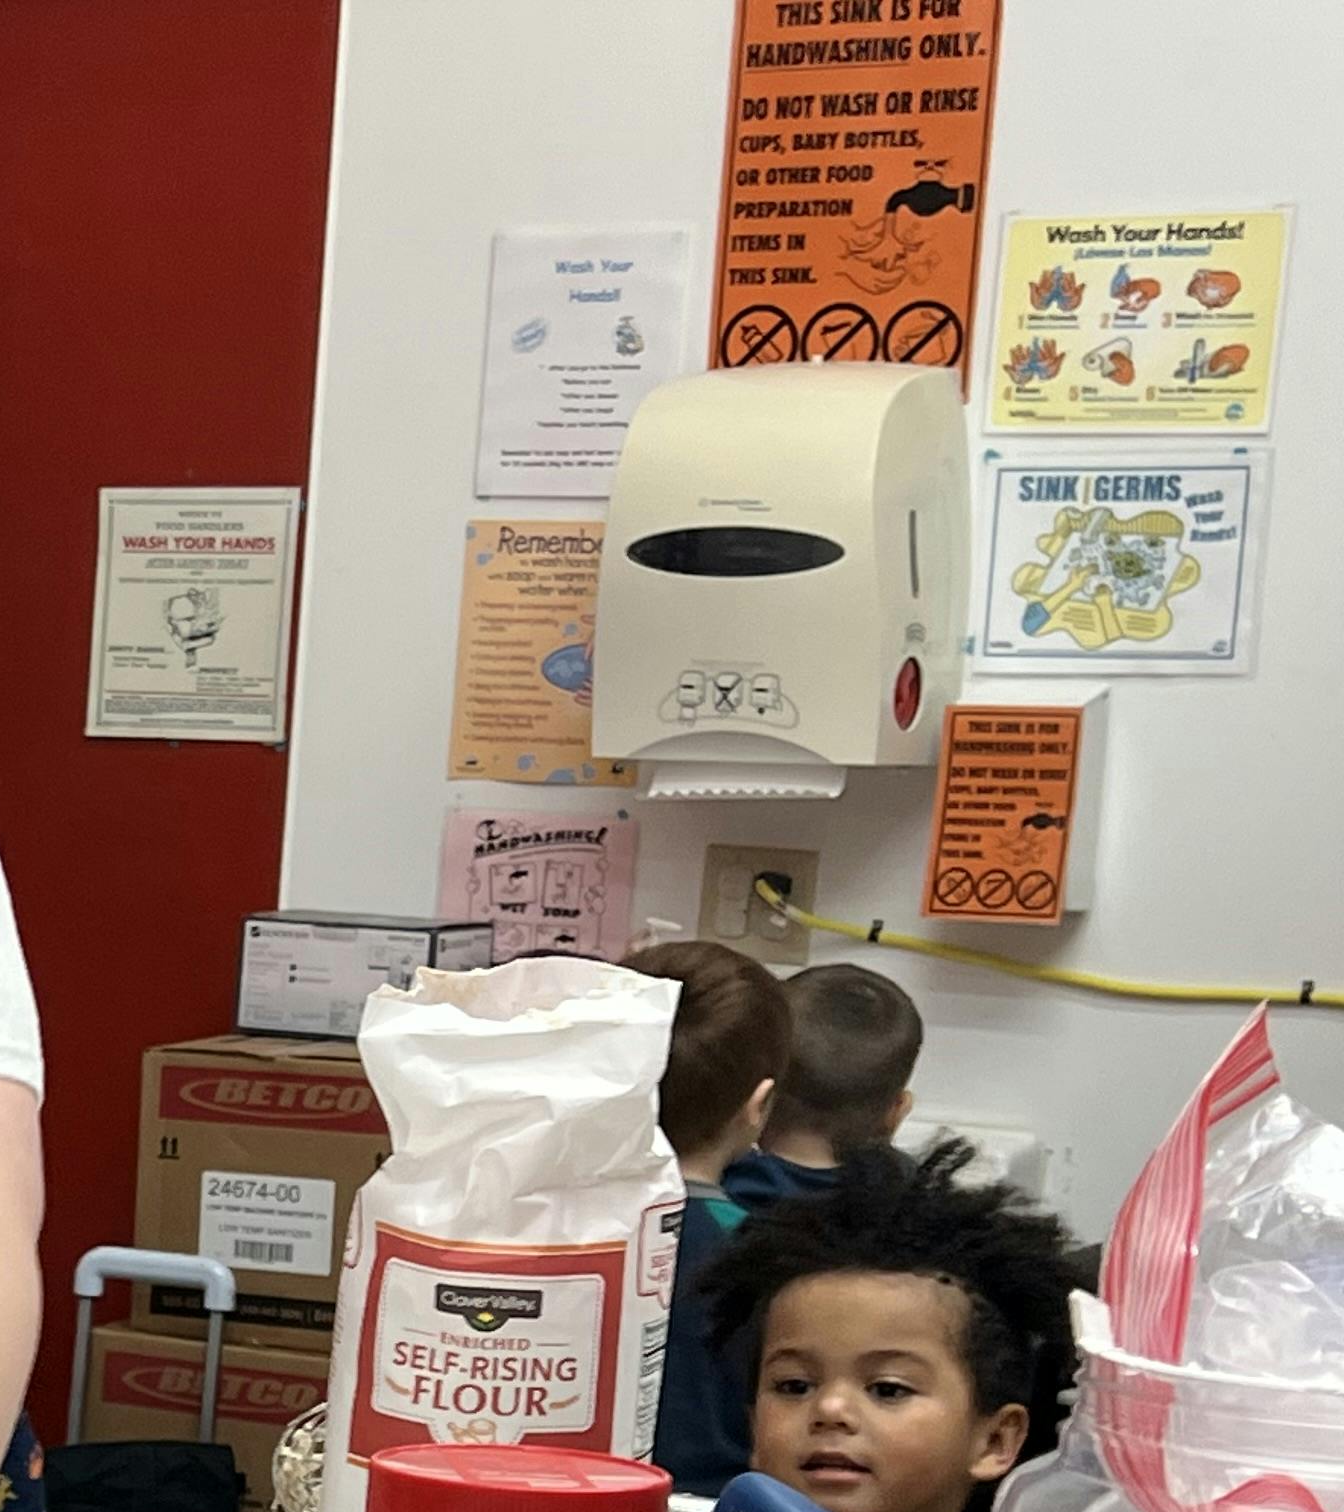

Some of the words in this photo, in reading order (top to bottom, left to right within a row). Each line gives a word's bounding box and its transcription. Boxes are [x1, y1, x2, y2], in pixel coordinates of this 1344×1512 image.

[776, 2, 822, 28] THIS
[830, 0, 881, 25] SINK
[891, 0, 911, 21] IS
[746, 35, 912, 68] HANDWASHING
[919, 31, 987, 59] ONLY.
[742, 97, 768, 121] DO
[775, 95, 814, 120] NOT
[821, 92, 879, 117] WASH
[885, 90, 913, 115] OR
[919, 88, 980, 113] RINSE
[739, 134, 786, 155] CUPS,
[792, 132, 839, 152] BABY
[844, 129, 924, 150] BOTTLES,
[736, 167, 759, 187] OR
[765, 166, 820, 185] OTHER
[825, 165, 873, 183] FOOD
[733, 200, 853, 219] PREPARATION
[731, 234, 781, 253] ITEMS
[787, 234, 806, 250] IN
[1046, 225, 1106, 244] Wash
[1112, 224, 1163, 243] Your
[1166, 221, 1245, 242] Hands!
[728, 268, 766, 286] THIS
[771, 267, 818, 285] SINK.
[1019, 475, 1079, 502] SINK
[1094, 474, 1182, 502] GERMS
[122, 536, 169, 550] WASH
[173, 536, 216, 550] YOUR
[221, 537, 276, 551] HANDS
[474, 826, 608, 855] HANDWASHING!
[213, 1078, 376, 1113] BETCO
[439, 1288, 488, 1311] Clover
[440, 1332, 531, 1352] ENRICHED
[393, 1341, 578, 1383] SELF-RISING
[157, 1365, 318, 1409] BTCO
[410, 1375, 549, 1418] FLOUR
